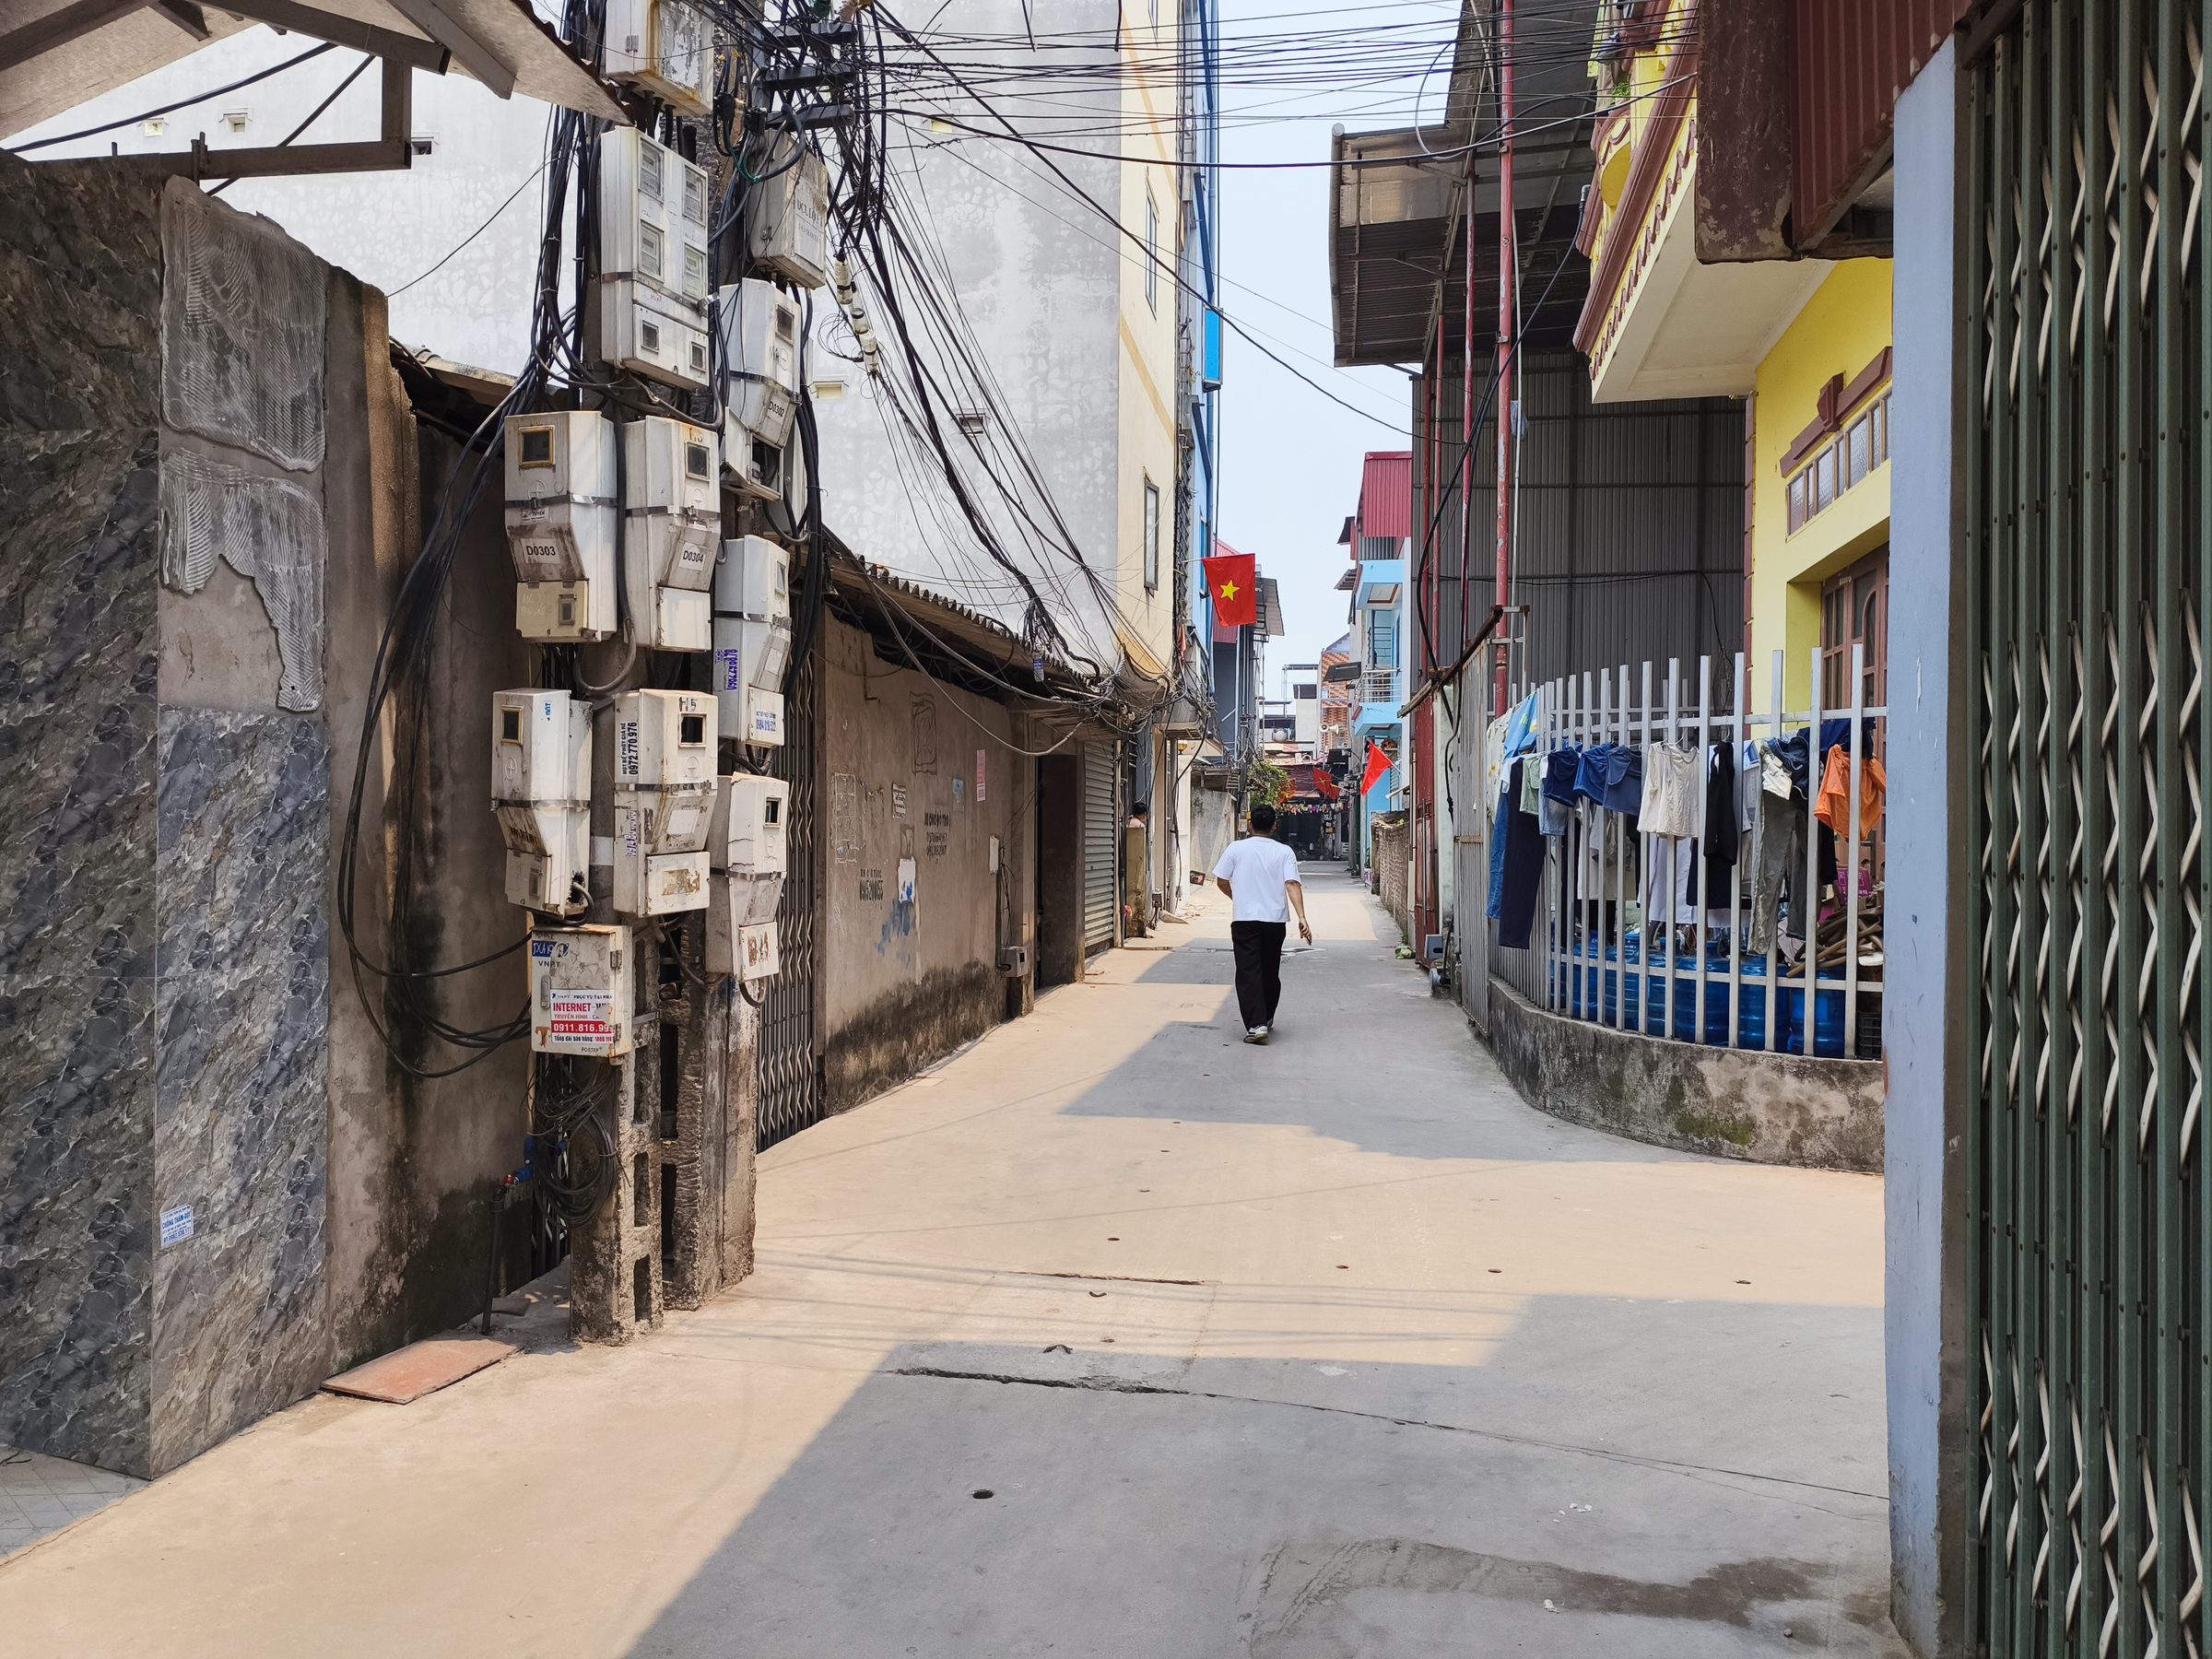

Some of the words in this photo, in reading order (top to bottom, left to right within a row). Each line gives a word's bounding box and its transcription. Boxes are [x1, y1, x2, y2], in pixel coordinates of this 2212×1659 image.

[768, 401, 785, 418] D0302
[525, 545, 556, 557] D0303
[682, 549, 704, 563] D0304
[628, 722, 639, 775] 0972.770.976
[553, 1002, 592, 1012] INTERNET
